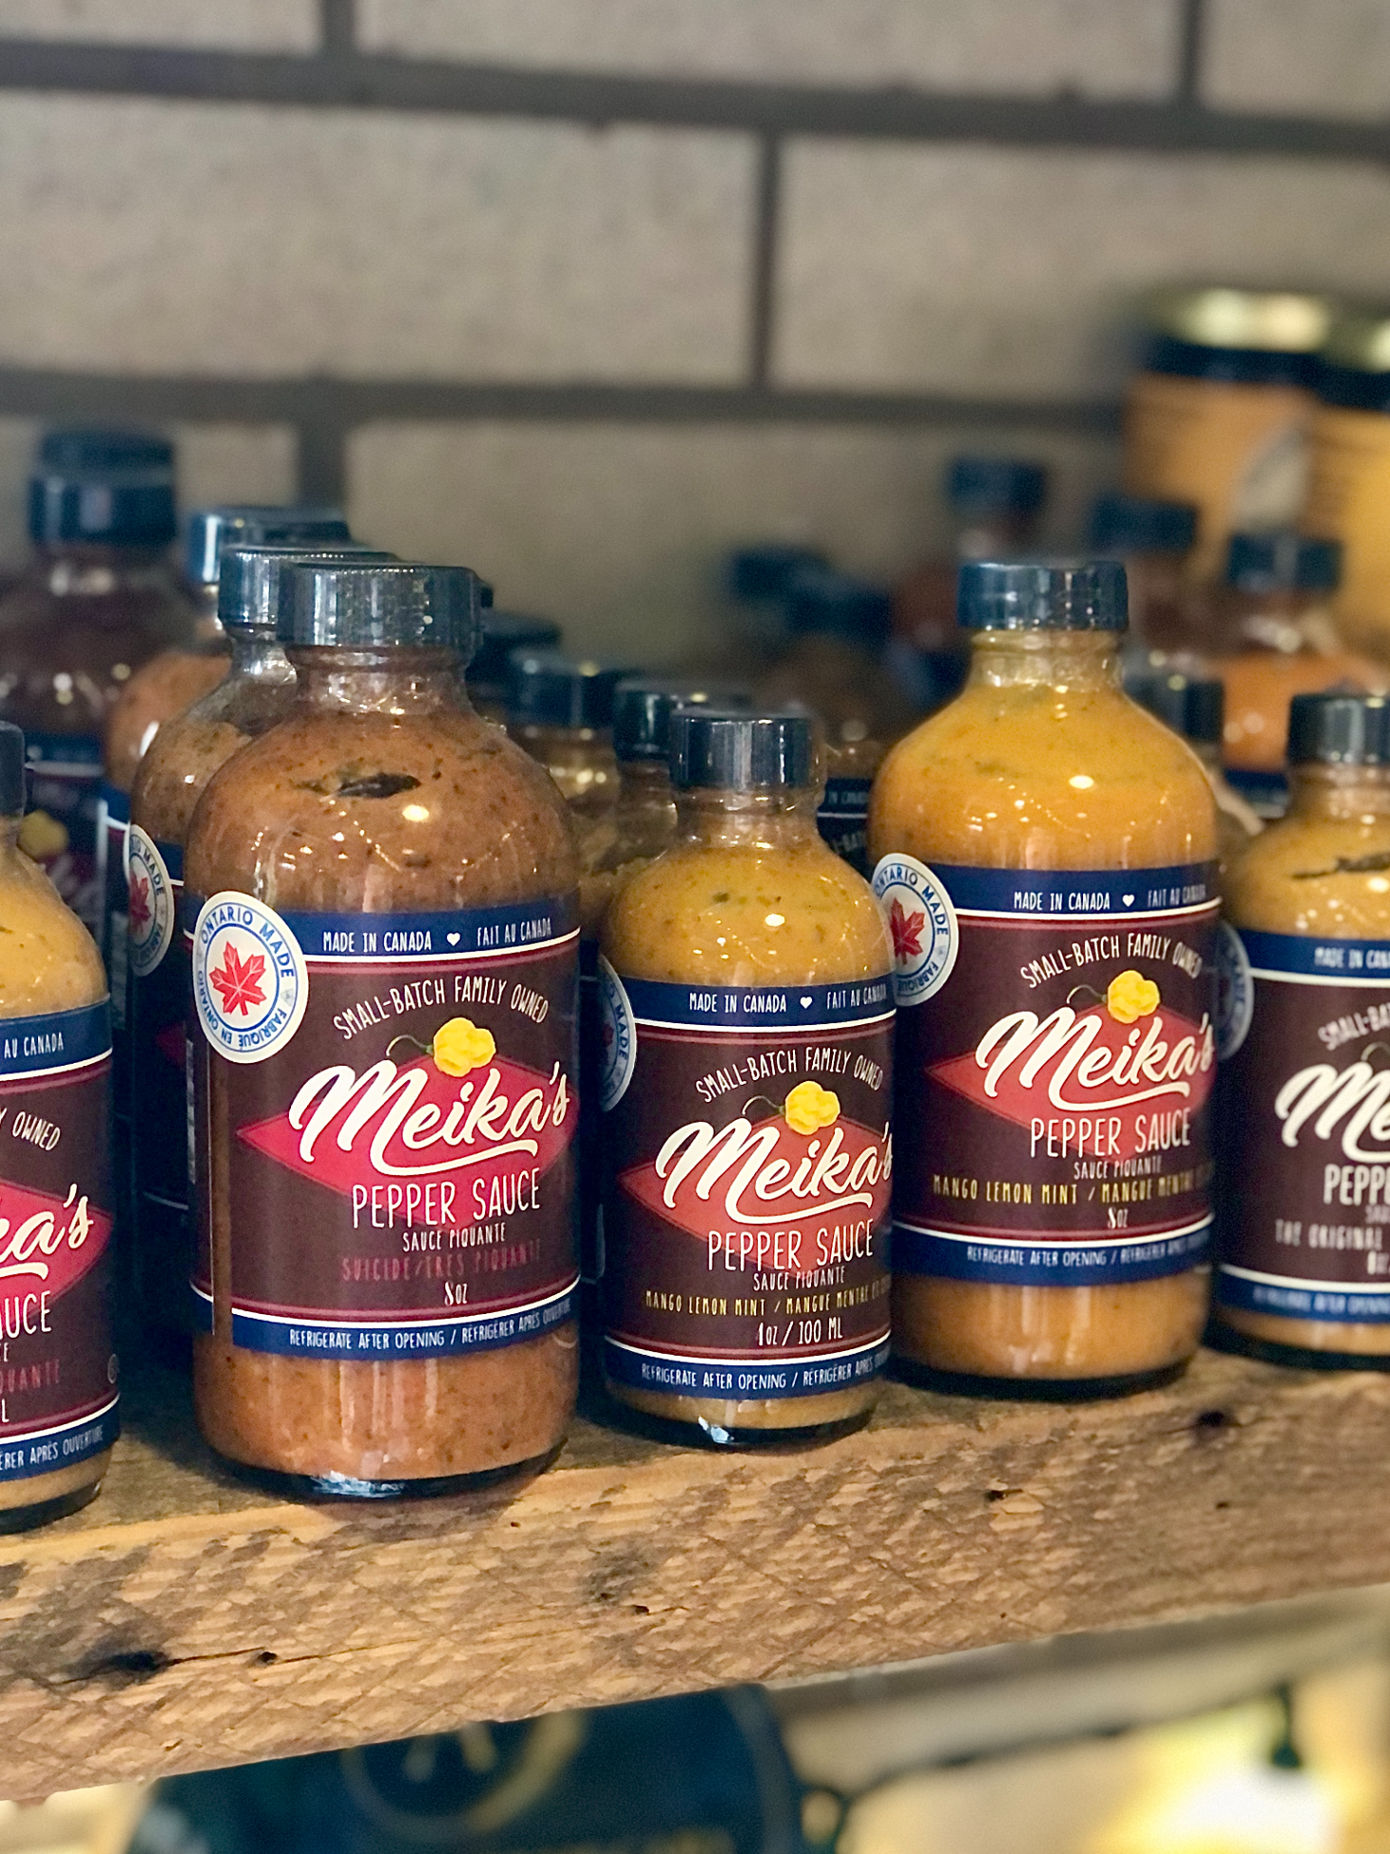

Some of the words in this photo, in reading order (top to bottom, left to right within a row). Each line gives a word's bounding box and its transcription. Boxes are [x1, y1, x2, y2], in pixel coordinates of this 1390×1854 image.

[921, 884, 949, 936] MADE
[1013, 891, 1043, 910] MADE
[1049, 892, 1063, 911] IN
[1068, 891, 1111, 911] CANADA
[1147, 888, 1167, 908] FAIT
[201, 905, 254, 944] ONTARIO
[258, 922, 295, 978] MADE
[323, 931, 355, 952] MADE
[362, 931, 377, 953] IN
[383, 930, 432, 952] CANADA
[476, 925, 500, 947] FAIT
[504, 924, 516, 944] AU
[520, 917, 552, 942] CANADA
[1019, 934, 1120, 989] SMALL-BATCH
[1127, 932, 1171, 960] FAMILY
[333, 977, 446, 1041] SMALL-BATCH
[454, 974, 508, 1005] FAMILY
[509, 983, 550, 1025] OWNED
[689, 992, 717, 1011] MADE
[724, 993, 737, 1013] IN
[743, 993, 787, 1013] CANADA
[826, 989, 847, 1010] FAIT
[850, 988, 860, 1008] AU
[220, 1029, 233, 1045] EN
[238, 1007, 288, 1048] FABRIQUE
[614, 1003, 629, 1061] MADE
[4, 1038, 19, 1059] AU
[23, 1031, 65, 1058] CANADA
[975, 1005, 1215, 1111] Meika's
[695, 1048, 798, 1103] SMALL-BATCH
[805, 1046, 852, 1074] FAMILY
[853, 1053, 884, 1092] OWNED
[12, 1110, 61, 1152] OWNED
[287, 1059, 571, 1177] Meika's
[1030, 1116, 1122, 1158] PEPPER
[1134, 1106, 1191, 1153] SAUCE
[655, 1117, 893, 1225] Meika's
[1073, 1160, 1109, 1181] SAUCE
[352, 1182, 456, 1229] PEPPER
[472, 1167, 541, 1221] SAUCE
[933, 1174, 978, 1200] MANGO
[986, 1180, 1032, 1205] LEMON
[1041, 1182, 1077, 1205] MINT
[1101, 1177, 1152, 1203] MANGUE
[402, 1231, 442, 1253] SAUCE
[449, 1222, 506, 1249] PIQUANTE
[708, 1230, 802, 1272] PEPPER
[816, 1218, 874, 1266] SAUCE
[967, 1245, 1025, 1267] REFRIGERATE
[1030, 1250, 1059, 1267] AFTER
[1062, 1249, 1107, 1267] OPENING
[752, 1271, 790, 1292] SAUCE
[795, 1266, 846, 1290] PIQUANTE
[646, 1289, 682, 1313] MANGO
[688, 1295, 727, 1316] LEMON
[734, 1298, 766, 1317] MINT
[786, 1293, 831, 1315] MANGUE
[290, 1328, 352, 1349] REFRIGERATE
[358, 1332, 390, 1349] AFTER
[395, 1329, 445, 1349] OPENING
[798, 1319, 822, 1344] 100
[828, 1316, 844, 1340] ML
[641, 1362, 698, 1387] REFRIGERATE
[703, 1371, 733, 1390] AFTER
[738, 1372, 787, 1390] OPENING
